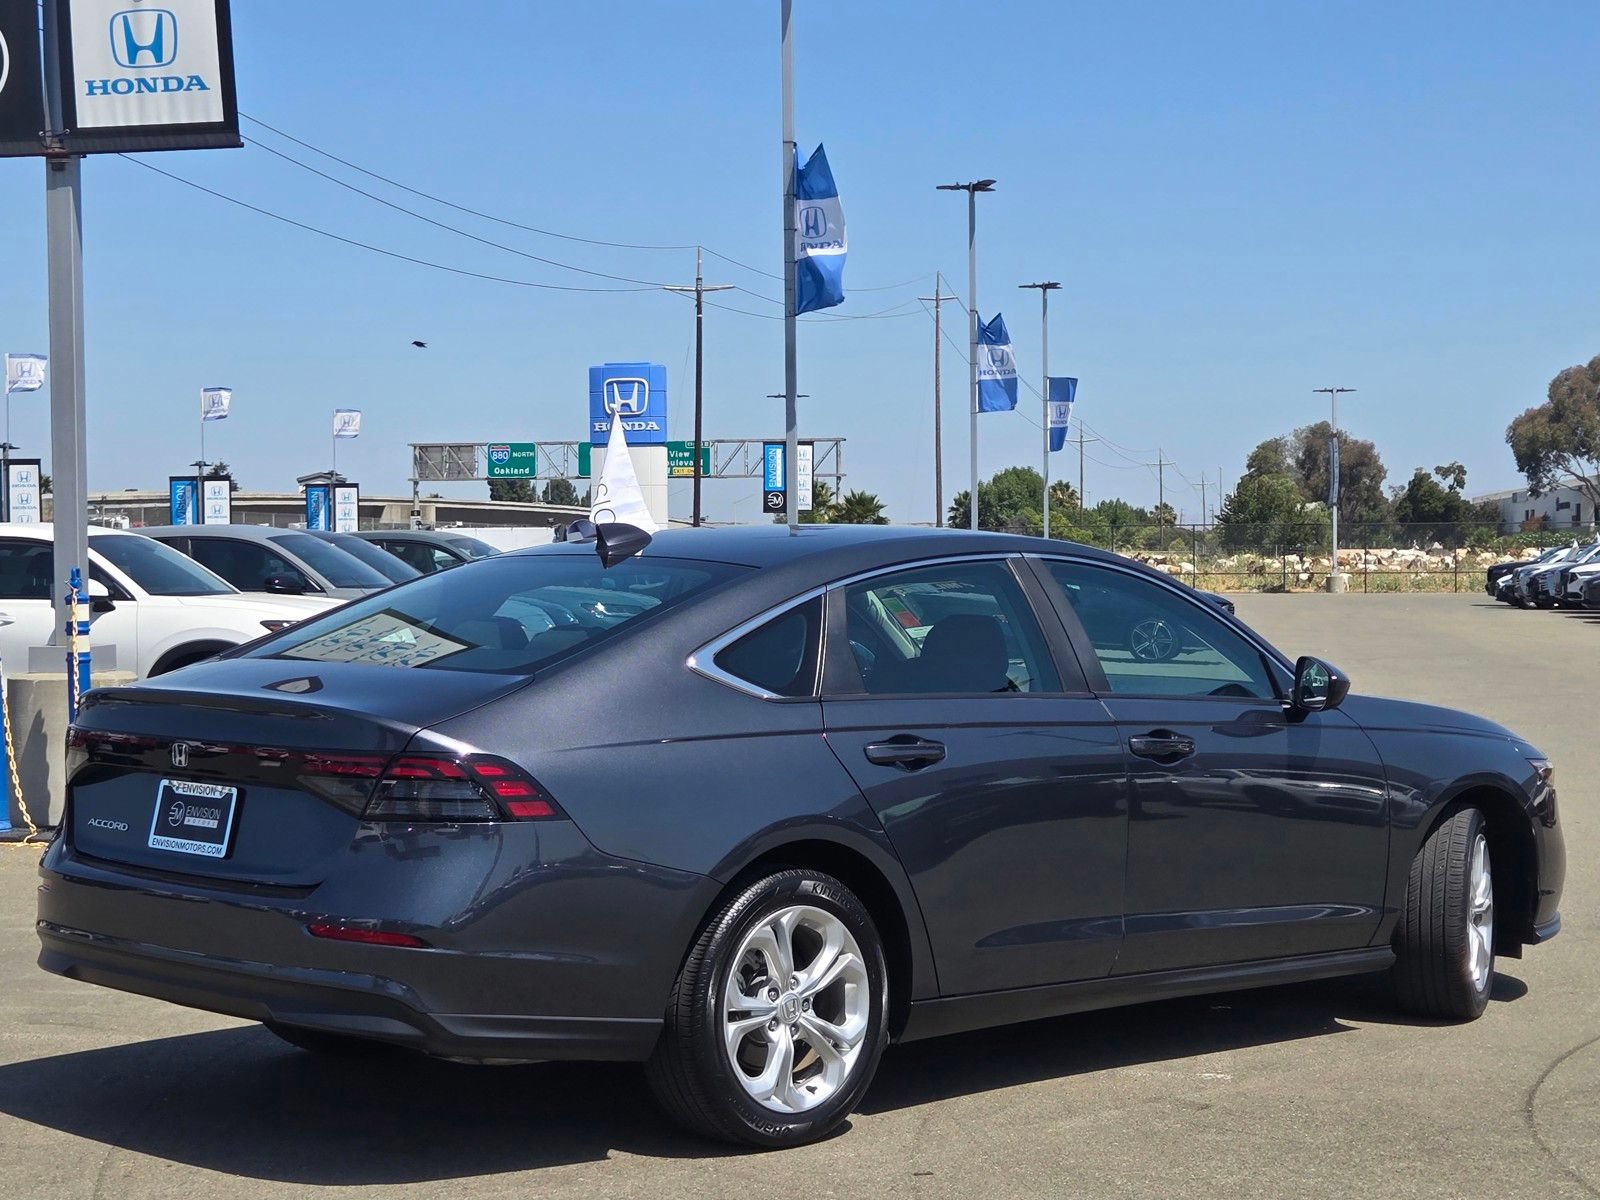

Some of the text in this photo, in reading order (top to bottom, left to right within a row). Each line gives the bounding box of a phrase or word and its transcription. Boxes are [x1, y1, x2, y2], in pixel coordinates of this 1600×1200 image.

[85, 74, 210, 96] HONDA
[593, 421, 660, 432] HNDA
[492, 451, 509, 460] 880
[669, 450, 691, 458] View
[666, 459, 704, 467] uleva
[768, 448, 777, 488] ENVISION
[493, 467, 530, 475] Oakland
[176, 485, 186, 526] NVISION
[182, 783, 217, 796] ENVISION
[185, 805, 221, 820] ENVISION
[87, 817, 129, 831] ACCORD
[151, 837, 223, 855] ENVISIONMOTORS.COM
